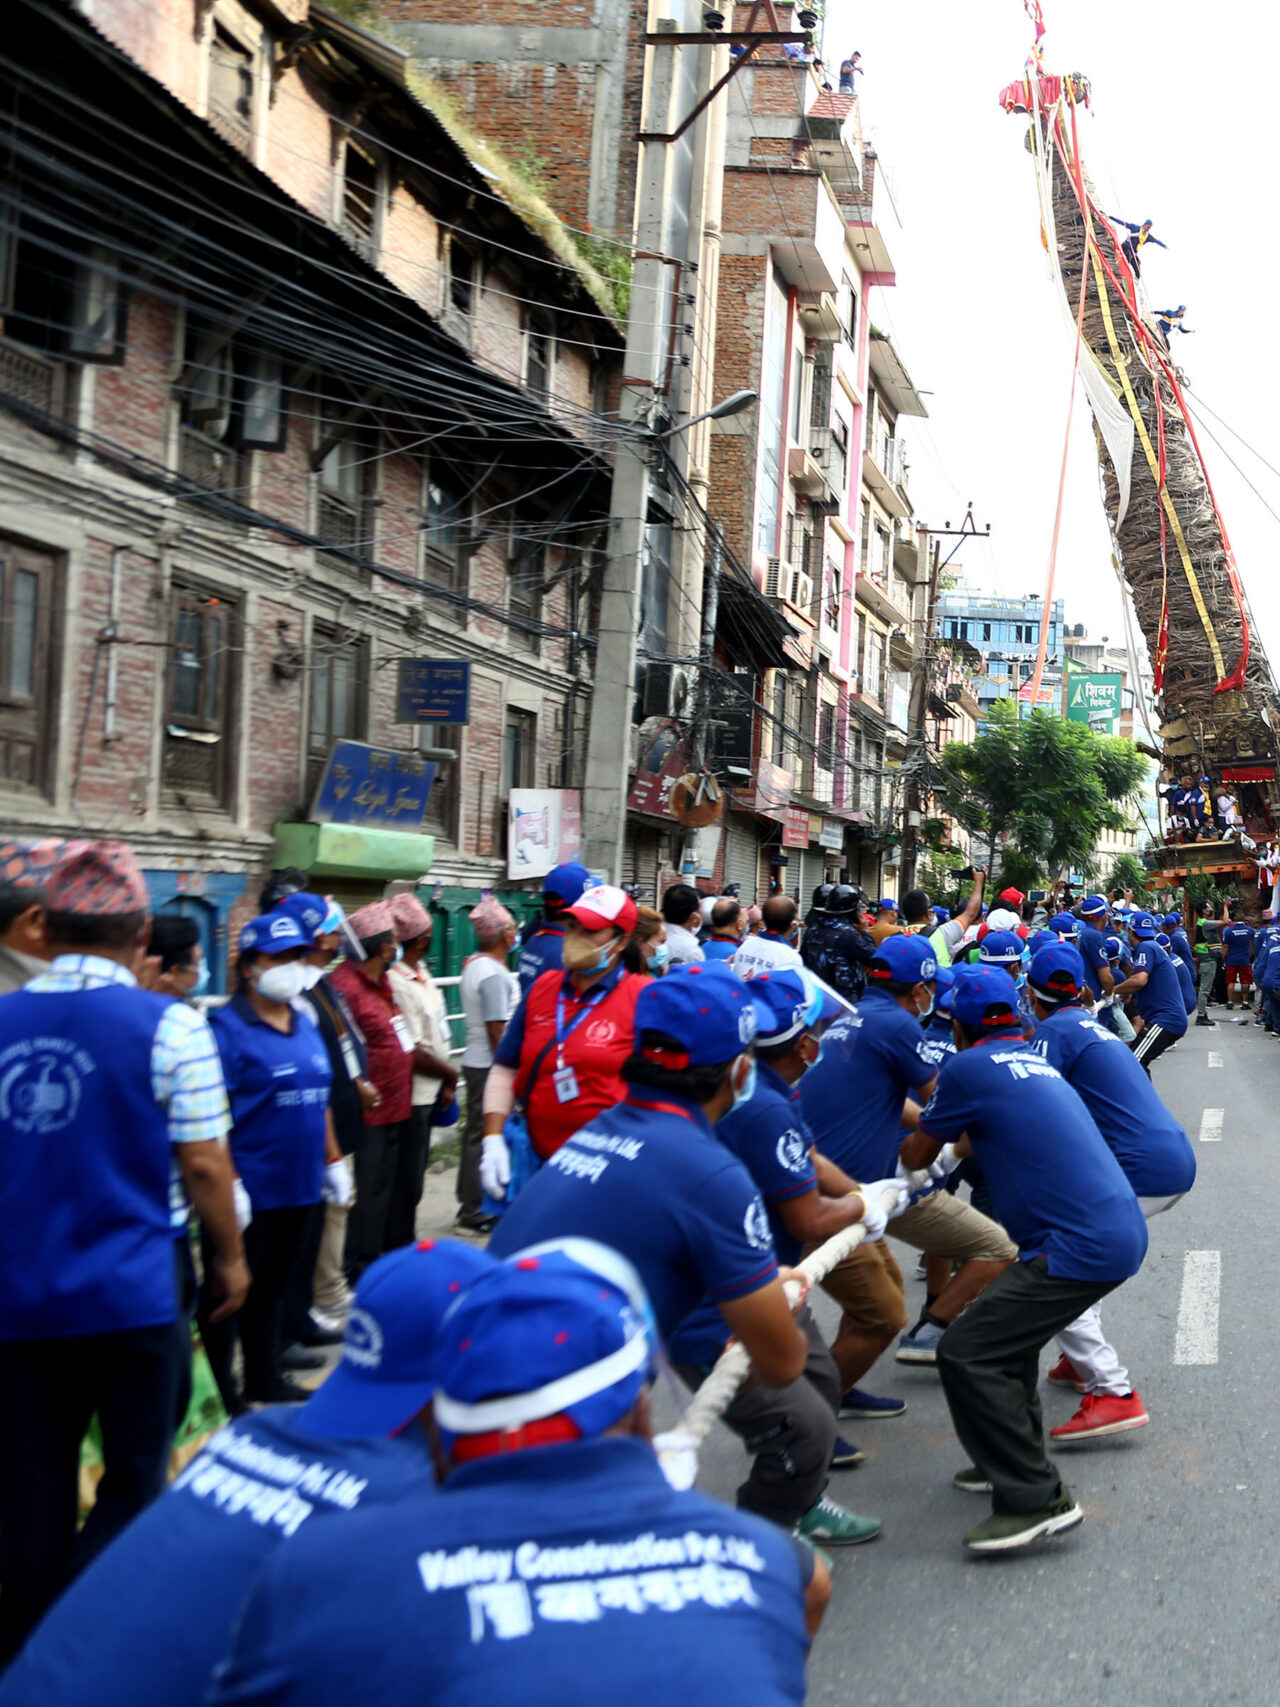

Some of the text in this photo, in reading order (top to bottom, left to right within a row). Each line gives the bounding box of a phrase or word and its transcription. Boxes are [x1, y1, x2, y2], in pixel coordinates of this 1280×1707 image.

[1085, 682, 1117, 703] शिवम्
[418, 1545, 514, 1593] Valley
[514, 1531, 687, 1581] Construction
